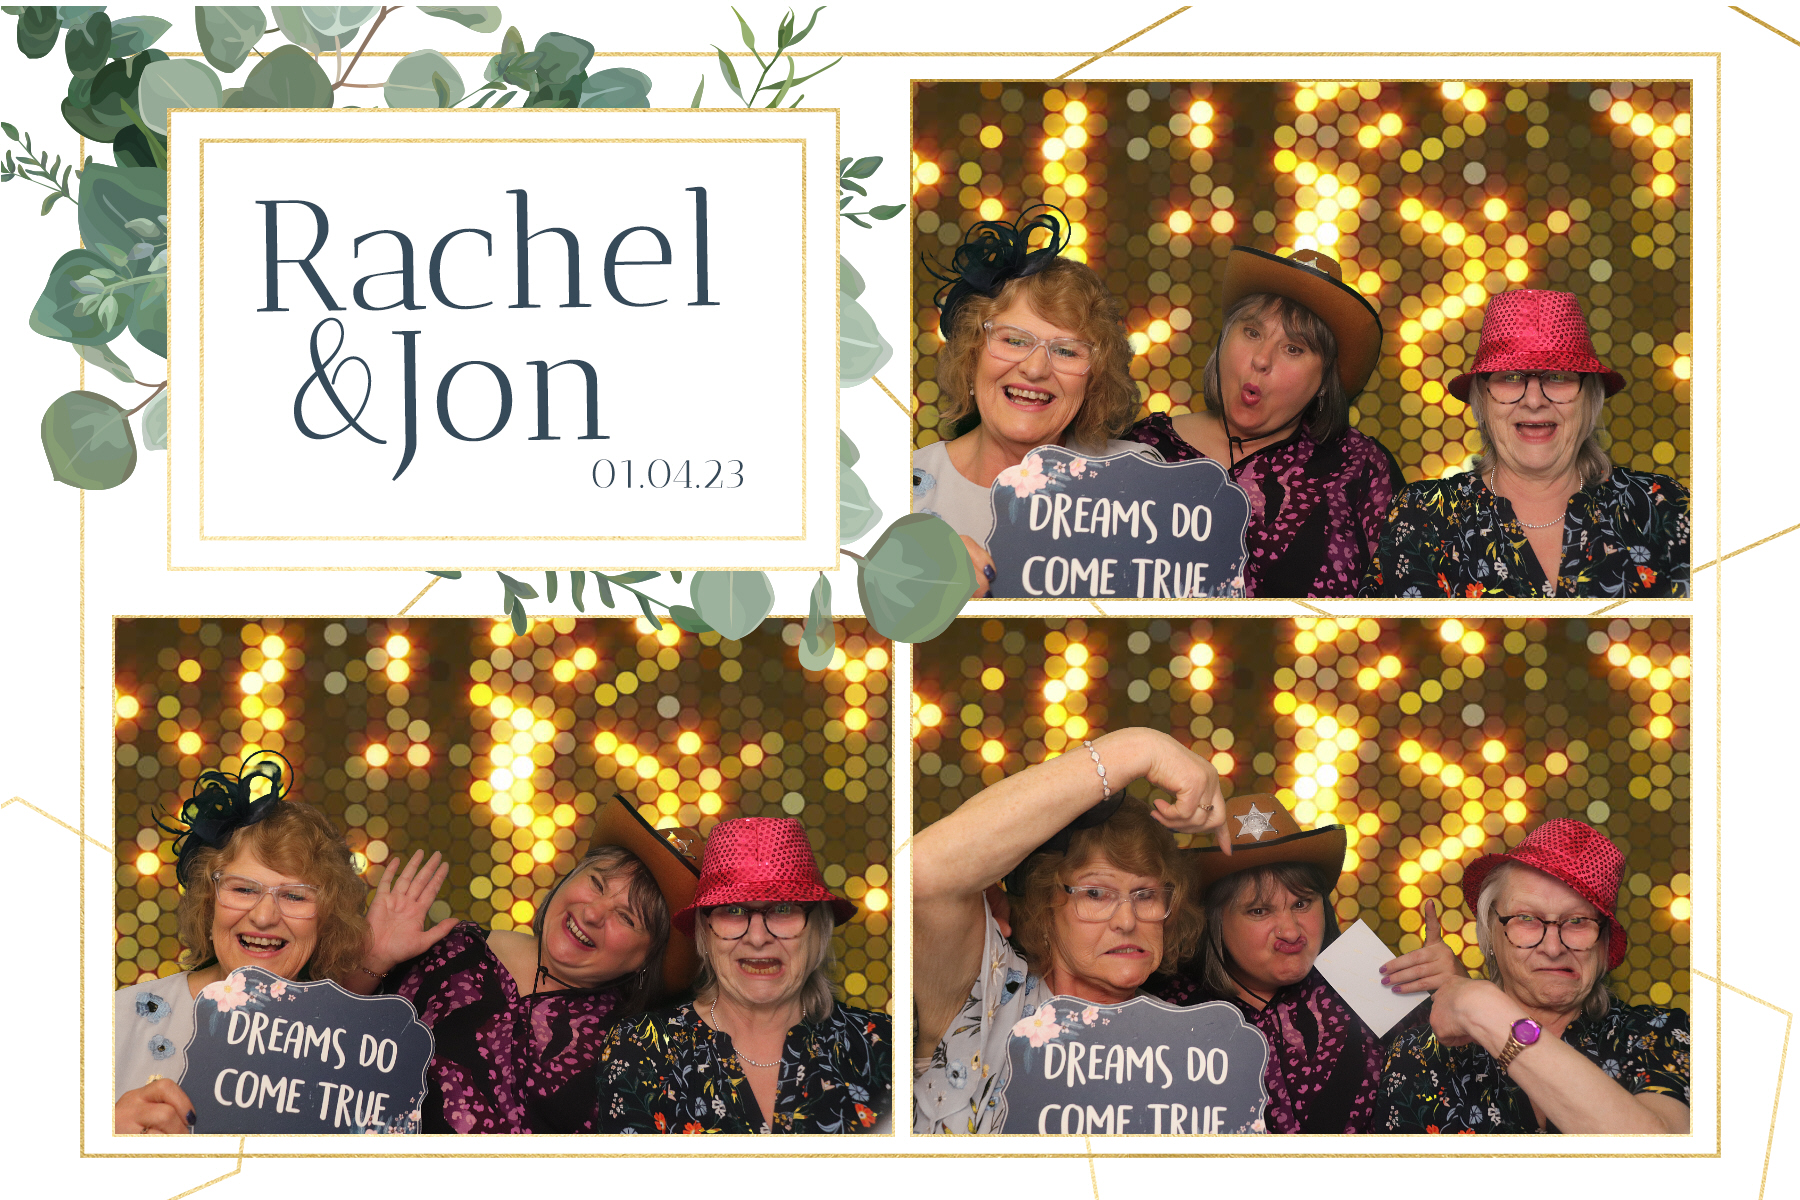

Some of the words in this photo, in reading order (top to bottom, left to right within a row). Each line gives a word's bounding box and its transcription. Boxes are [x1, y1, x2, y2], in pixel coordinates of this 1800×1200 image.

[1029, 493, 1157, 544] DREAMS
[1172, 503, 1212, 541] DO
[1022, 556, 1118, 597] COME
[1132, 558, 1209, 598] TRUE
[227, 1010, 346, 1069] DREAMS
[359, 1034, 398, 1073] DO
[1044, 1042, 1173, 1089] DREAMS
[1187, 1047, 1229, 1085] DO
[214, 1068, 305, 1113] COME
[318, 1081, 390, 1128] TRUE
[1038, 1103, 1133, 1134] COME
[1147, 1103, 1227, 1134] TRUE
